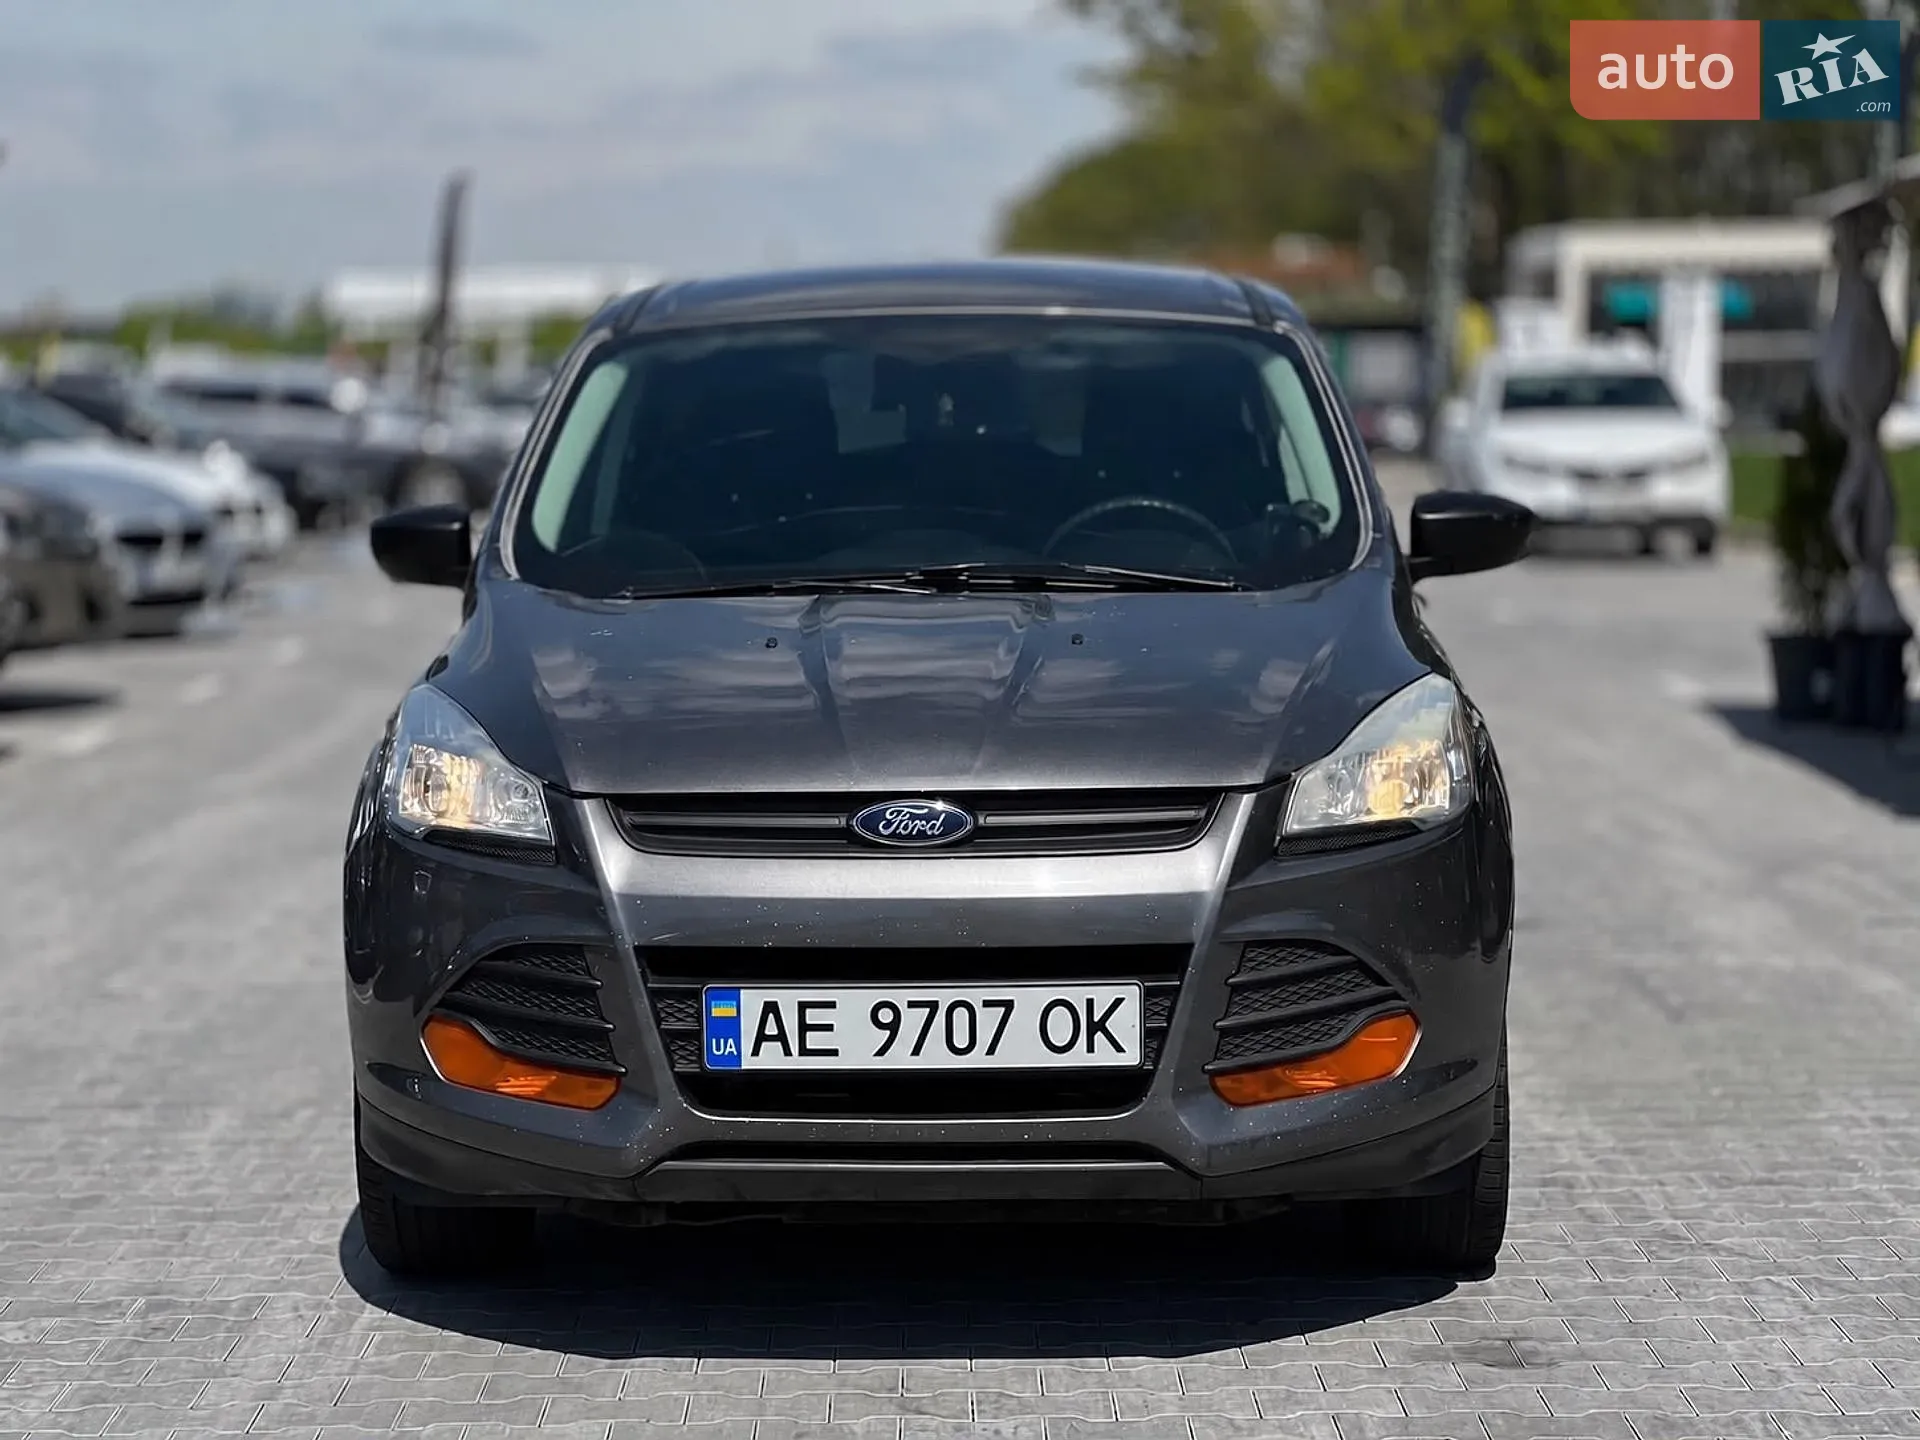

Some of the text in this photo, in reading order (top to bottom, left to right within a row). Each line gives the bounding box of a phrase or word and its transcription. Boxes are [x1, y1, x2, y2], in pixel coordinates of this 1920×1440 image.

[878, 807, 944, 836] Ford
[750, 997, 1127, 1058] AE 9707 OK
[711, 1037, 738, 1056] UA
